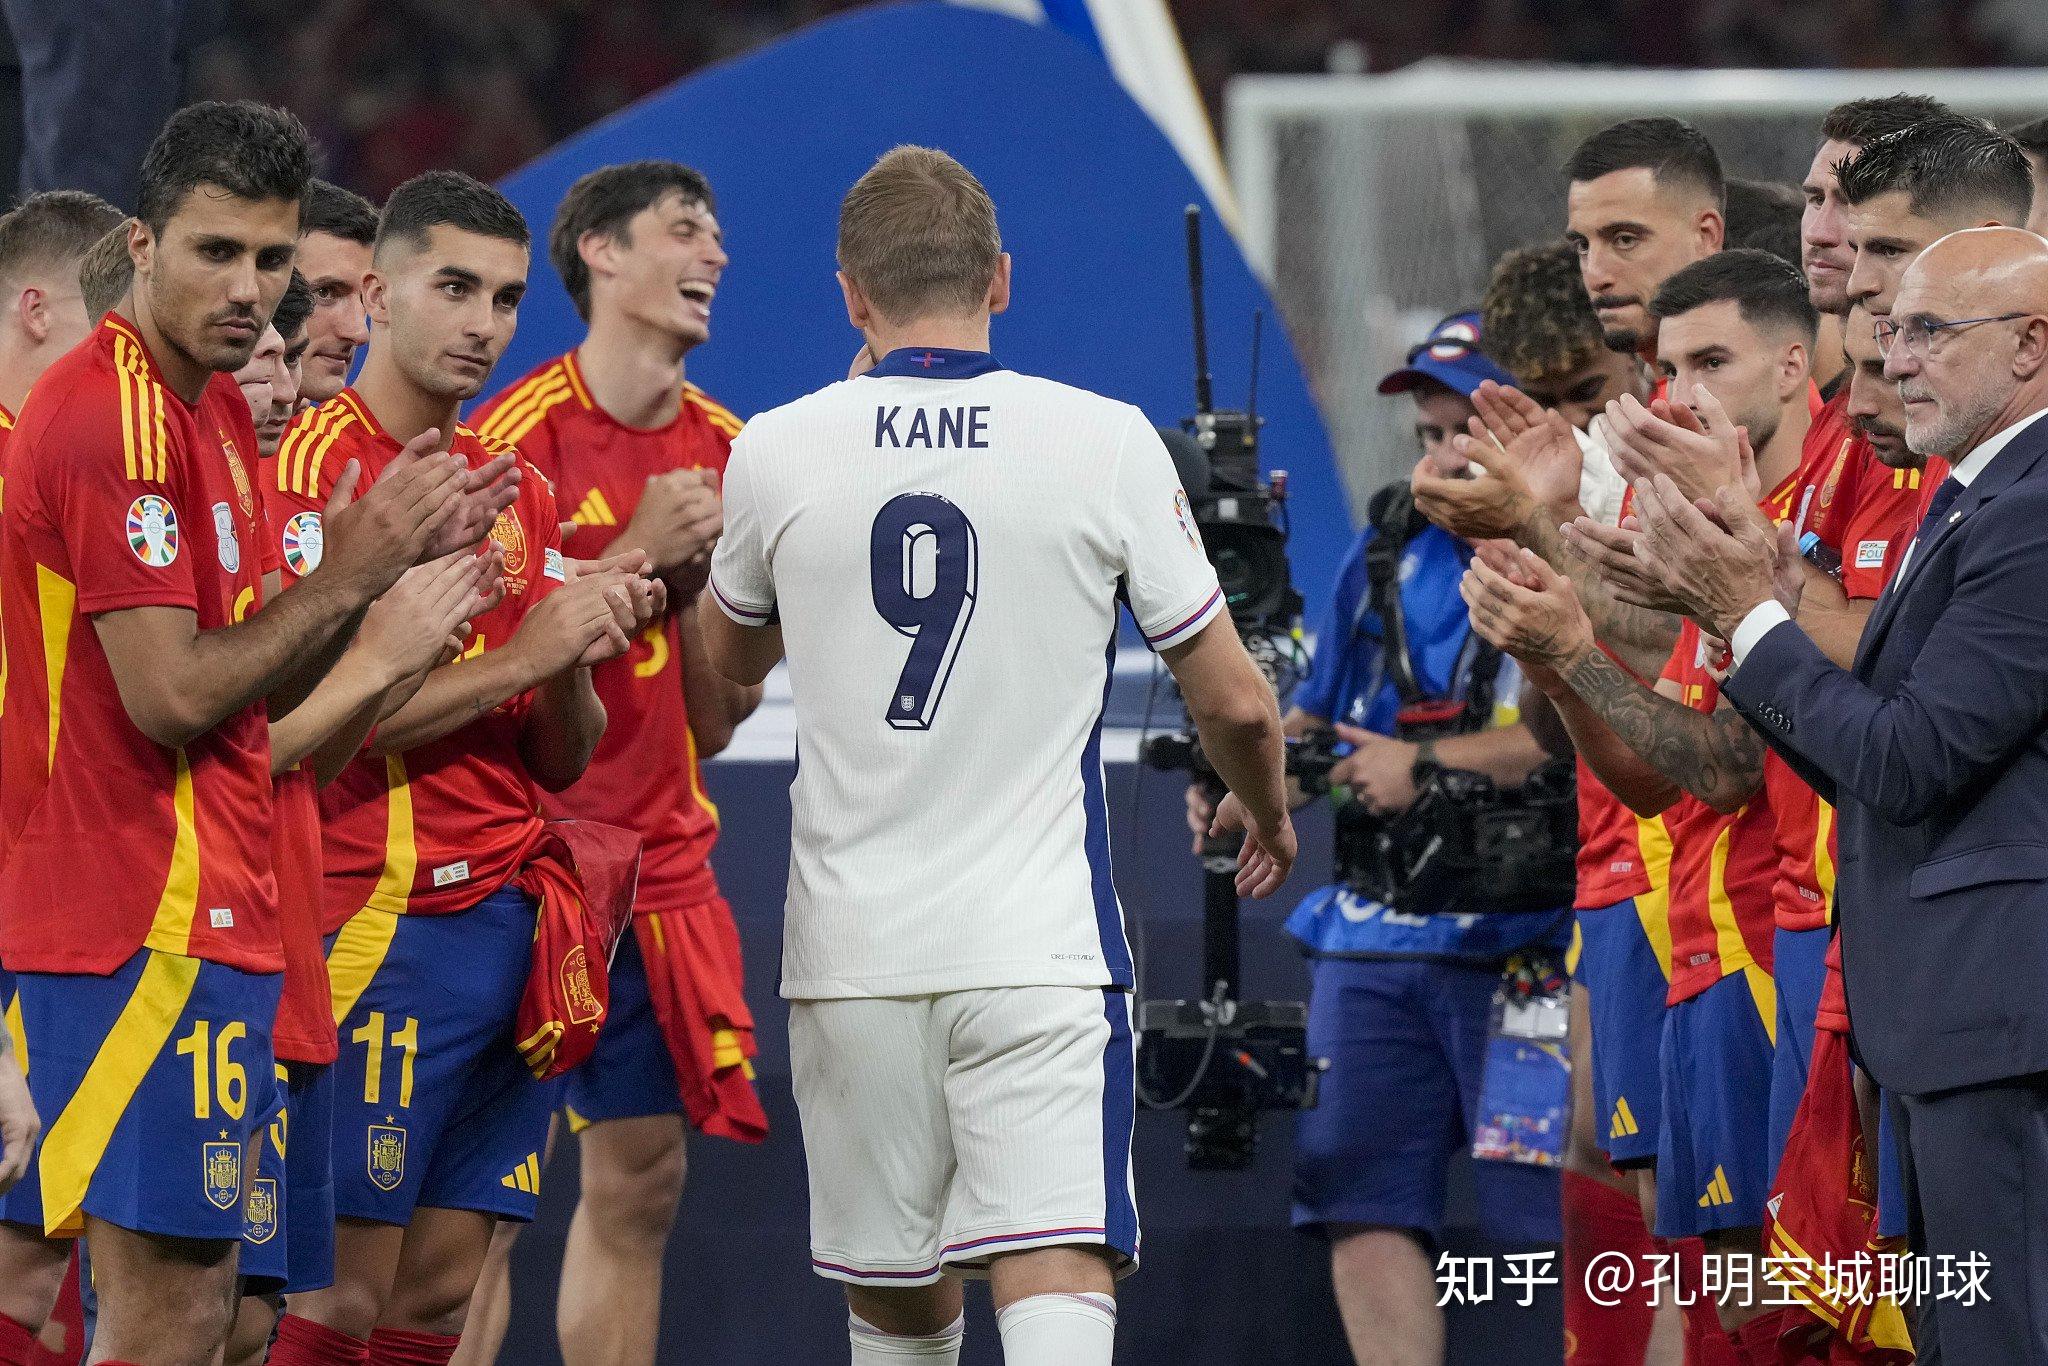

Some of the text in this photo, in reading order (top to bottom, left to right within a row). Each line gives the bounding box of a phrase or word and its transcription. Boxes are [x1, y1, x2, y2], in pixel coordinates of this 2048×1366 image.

[874, 405, 990, 449] KANE
[869, 491, 979, 731] 9
[176, 1020, 247, 1120] 16
[352, 1011, 418, 1108] 11
